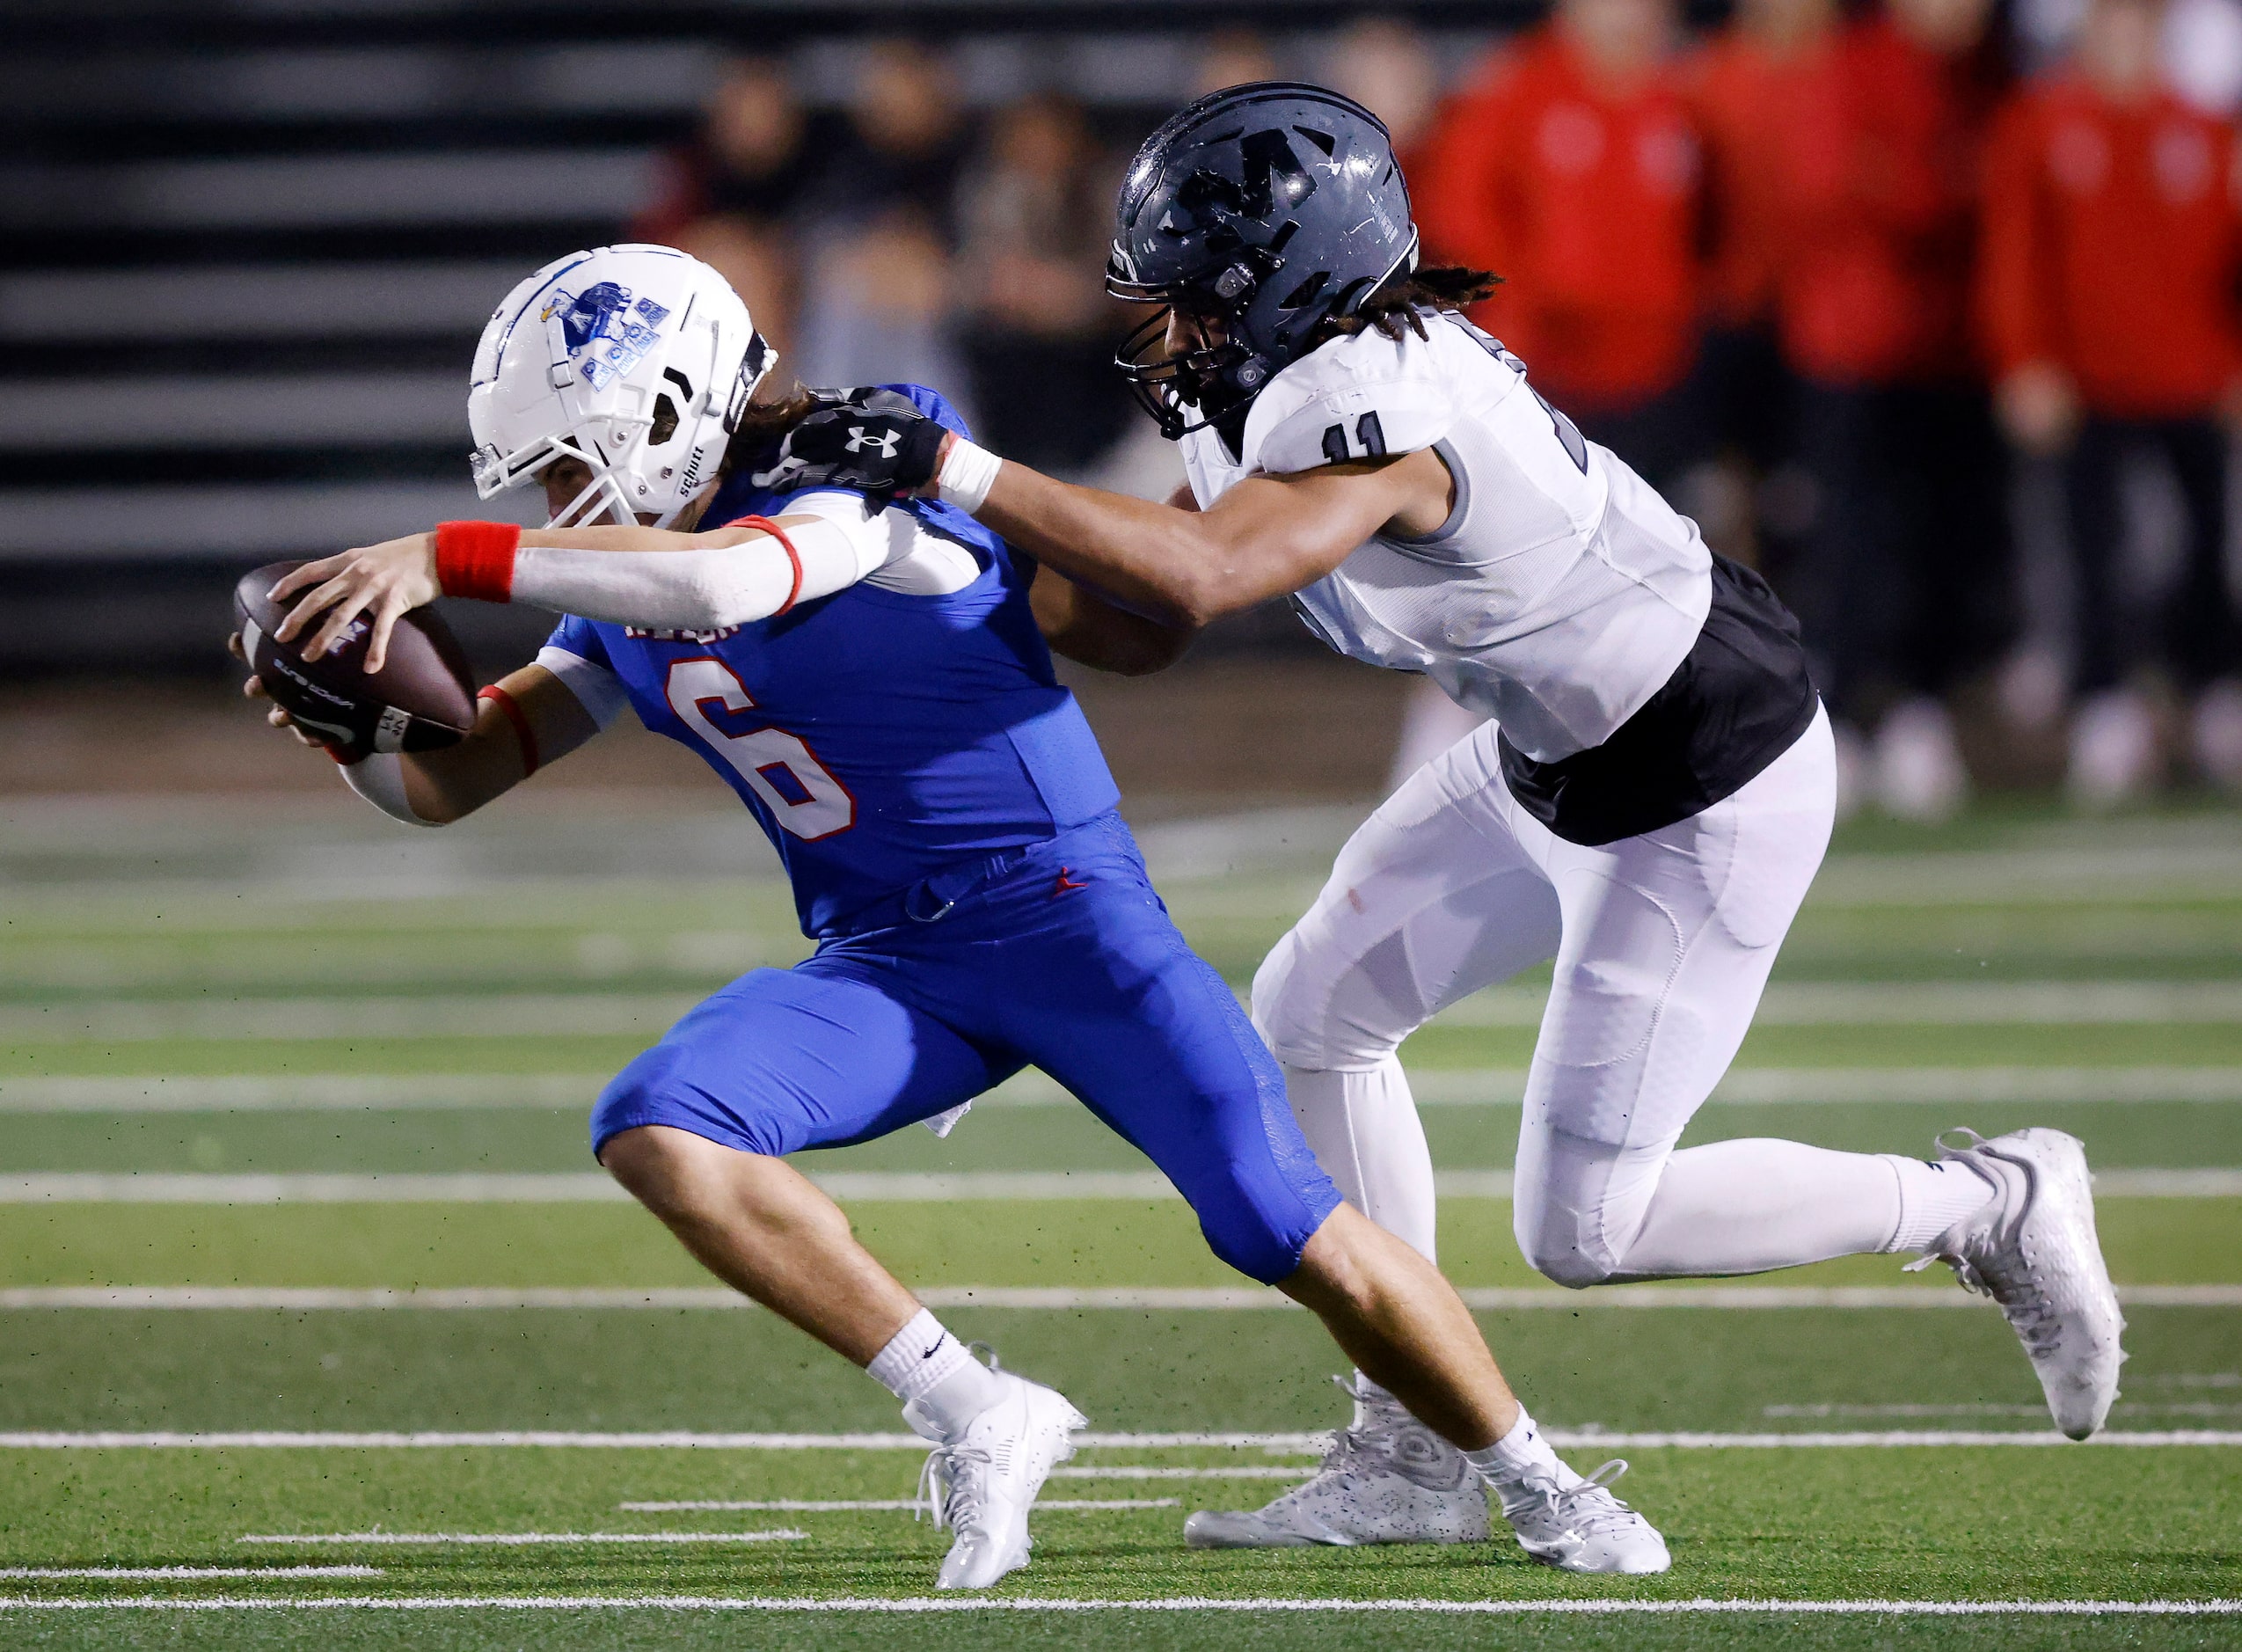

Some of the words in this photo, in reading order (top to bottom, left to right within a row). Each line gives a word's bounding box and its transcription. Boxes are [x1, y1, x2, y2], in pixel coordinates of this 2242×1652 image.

[1322, 410, 1387, 461] 11
[680, 446, 705, 498] schutt
[664, 656, 857, 842] 6
